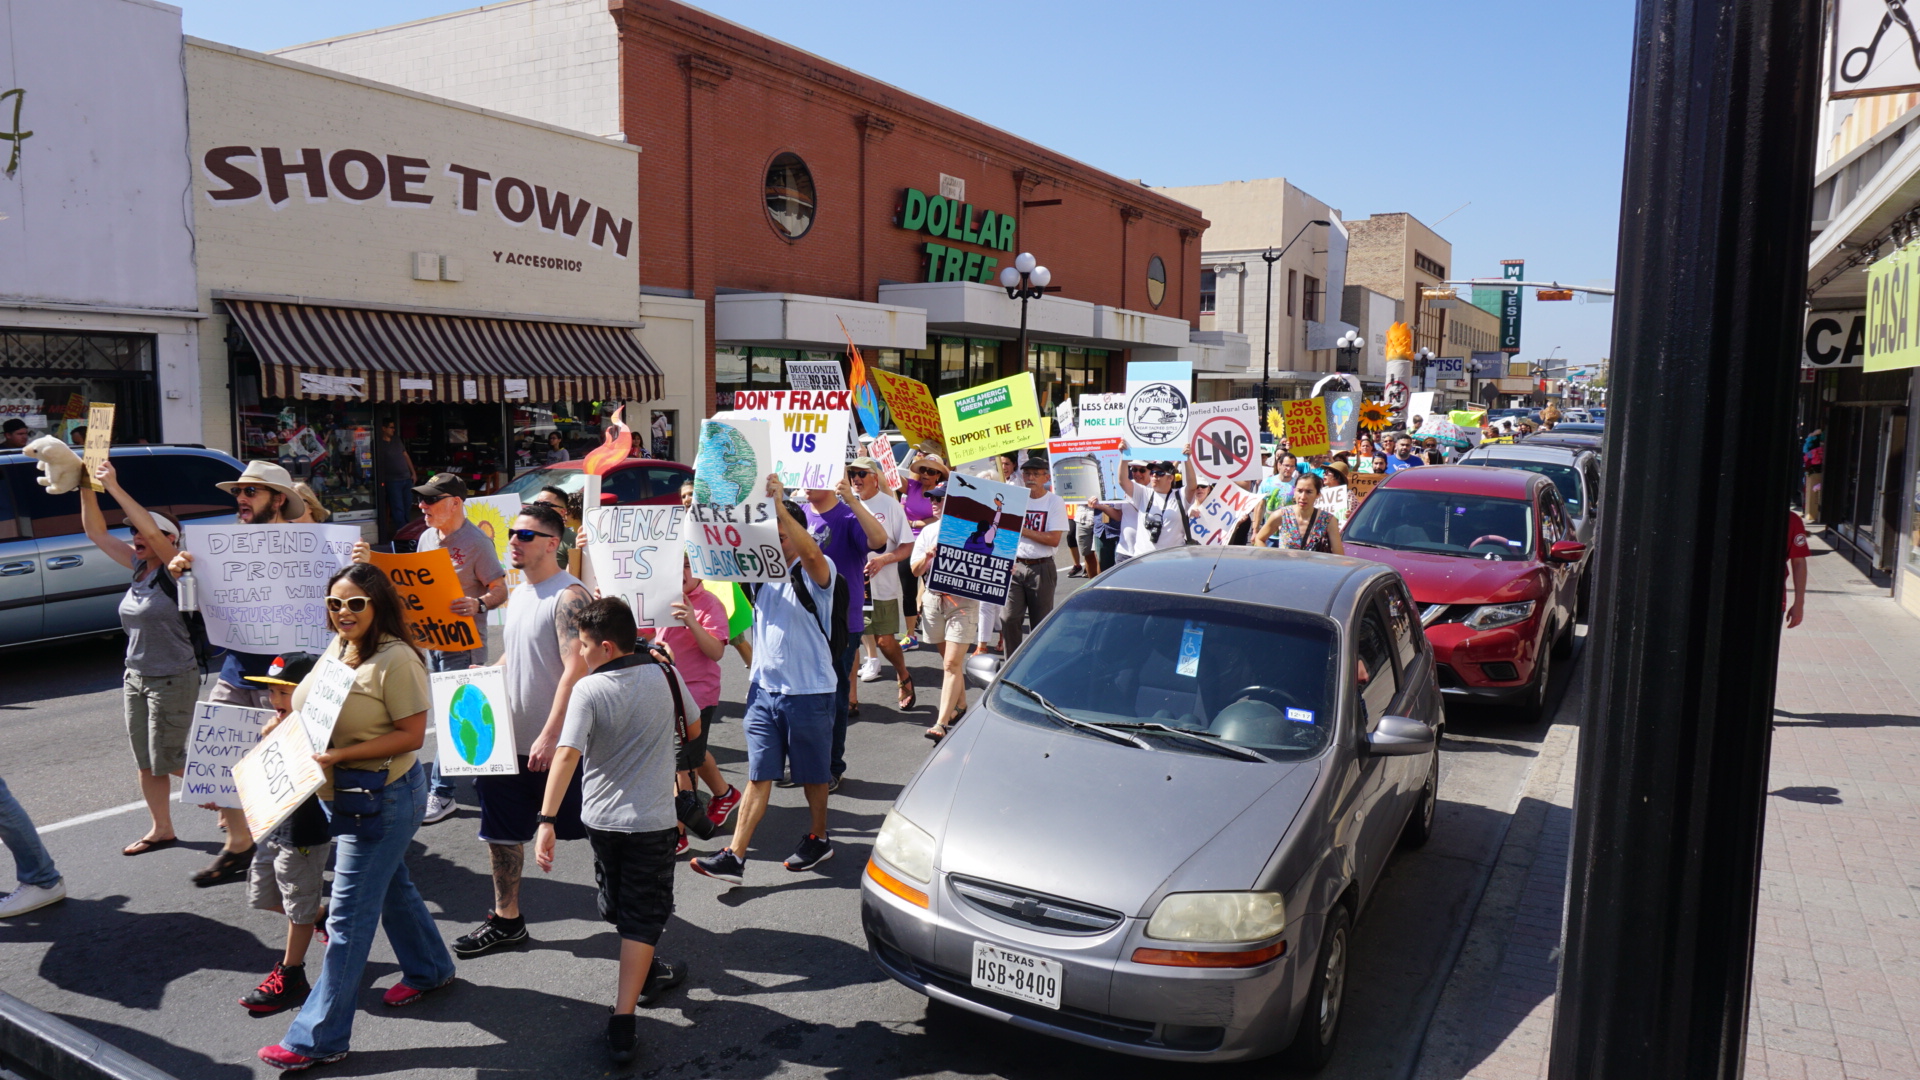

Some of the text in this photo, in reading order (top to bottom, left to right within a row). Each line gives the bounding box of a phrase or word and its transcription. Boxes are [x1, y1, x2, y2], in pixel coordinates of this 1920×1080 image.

[203, 145, 633, 257] SHOE TOWN
[902, 187, 1016, 252] DOLLAR
[493, 251, 583, 272] Y ACCESORIOS
[926, 242, 998, 283] TREE
[1869, 262, 1909, 357] CASA
[1805, 315, 1866, 365] CA
[789, 365, 838, 374] DECOLONIZE
[808, 375, 840, 385] NO BAN
[734, 390, 850, 411] DON'T FRACK
[956, 387, 1008, 407] MAKE AMERICA
[960, 402, 983, 412] GREEN
[984, 394, 1006, 406] AGAIN
[1081, 403, 1102, 411] LESS
[1292, 400, 1312, 408] NO
[1212, 405, 1240, 414] Natural
[1241, 402, 1256, 411] Gas
[1286, 406, 1322, 418] JOBS
[783, 413, 828, 433] WITH
[1084, 418, 1106, 426] MORE
[1287, 416, 1322, 426] ON A
[1290, 424, 1325, 434] DEAD
[950, 418, 1034, 446] SUPPORT THE EPA
[1288, 432, 1327, 447] PLANET
[792, 433, 816, 453] US
[1197, 430, 1248, 466] LNG
[801, 462, 833, 488] Kills!
[1351, 474, 1380, 485] Prese
[744, 503, 769, 524] IS
[1025, 513, 1041, 531] NG
[585, 505, 686, 545] SCIENCE
[703, 524, 742, 547] NO
[208, 530, 354, 556] DEFEND AND
[613, 546, 657, 580] IS
[760, 545, 786, 578] B
[940, 545, 1010, 571] PROTECT THE
[223, 560, 337, 581] PROTECT
[391, 568, 434, 586] are
[938, 556, 1007, 585] WATER
[214, 585, 329, 603] THAT WHIC
[933, 572, 964, 588] DEFEND
[966, 580, 981, 593] THE
[982, 584, 1005, 598] LAND
[225, 624, 331, 650] ALL LIF
[411, 617, 475, 647] sition
[201, 705, 265, 726] IF THE
[187, 761, 215, 778] FOR
[260, 741, 295, 804] RESIST
[188, 782, 216, 794] WHO
[1000, 951, 1034, 968] TEXAS
